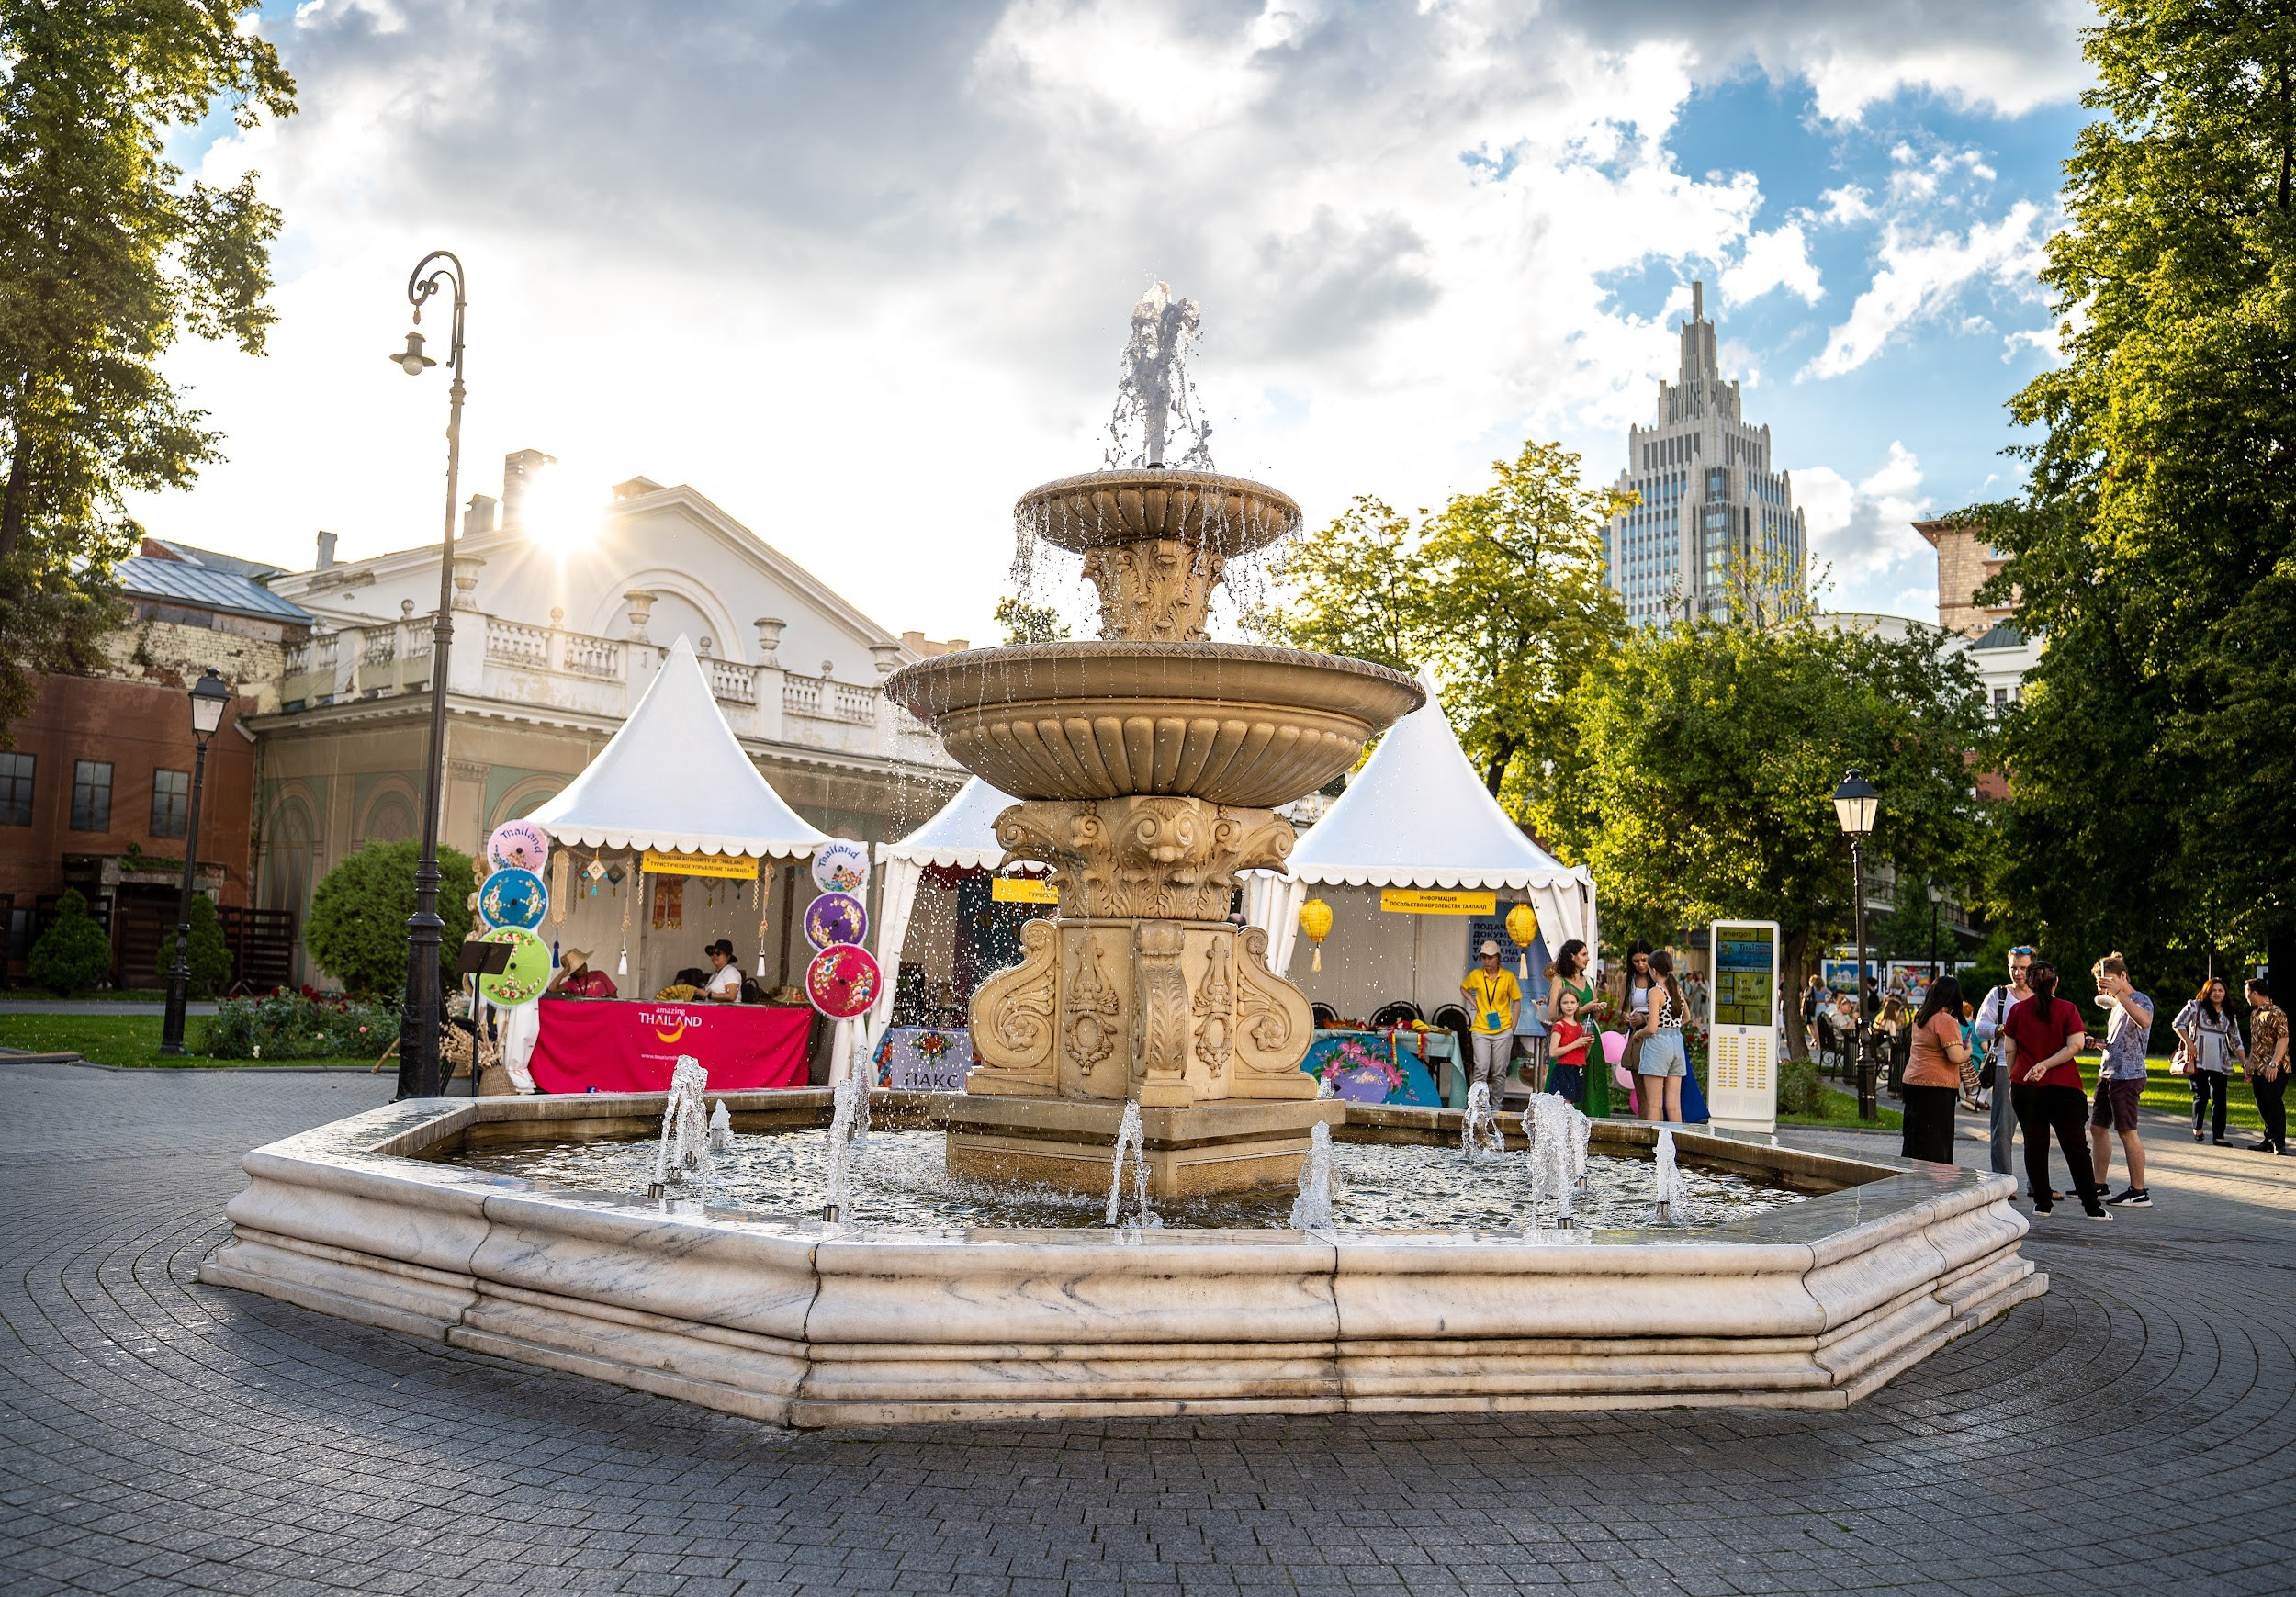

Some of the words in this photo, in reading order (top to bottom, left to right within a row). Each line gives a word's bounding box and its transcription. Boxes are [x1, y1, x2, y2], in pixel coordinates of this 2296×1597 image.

[500, 827, 543, 853] Thailand
[817, 844, 860, 867] Thailand
[638, 1012, 703, 1027] THAILAND
[656, 1007, 686, 1017] amazing
[905, 1073, 959, 1088] ПАКС
